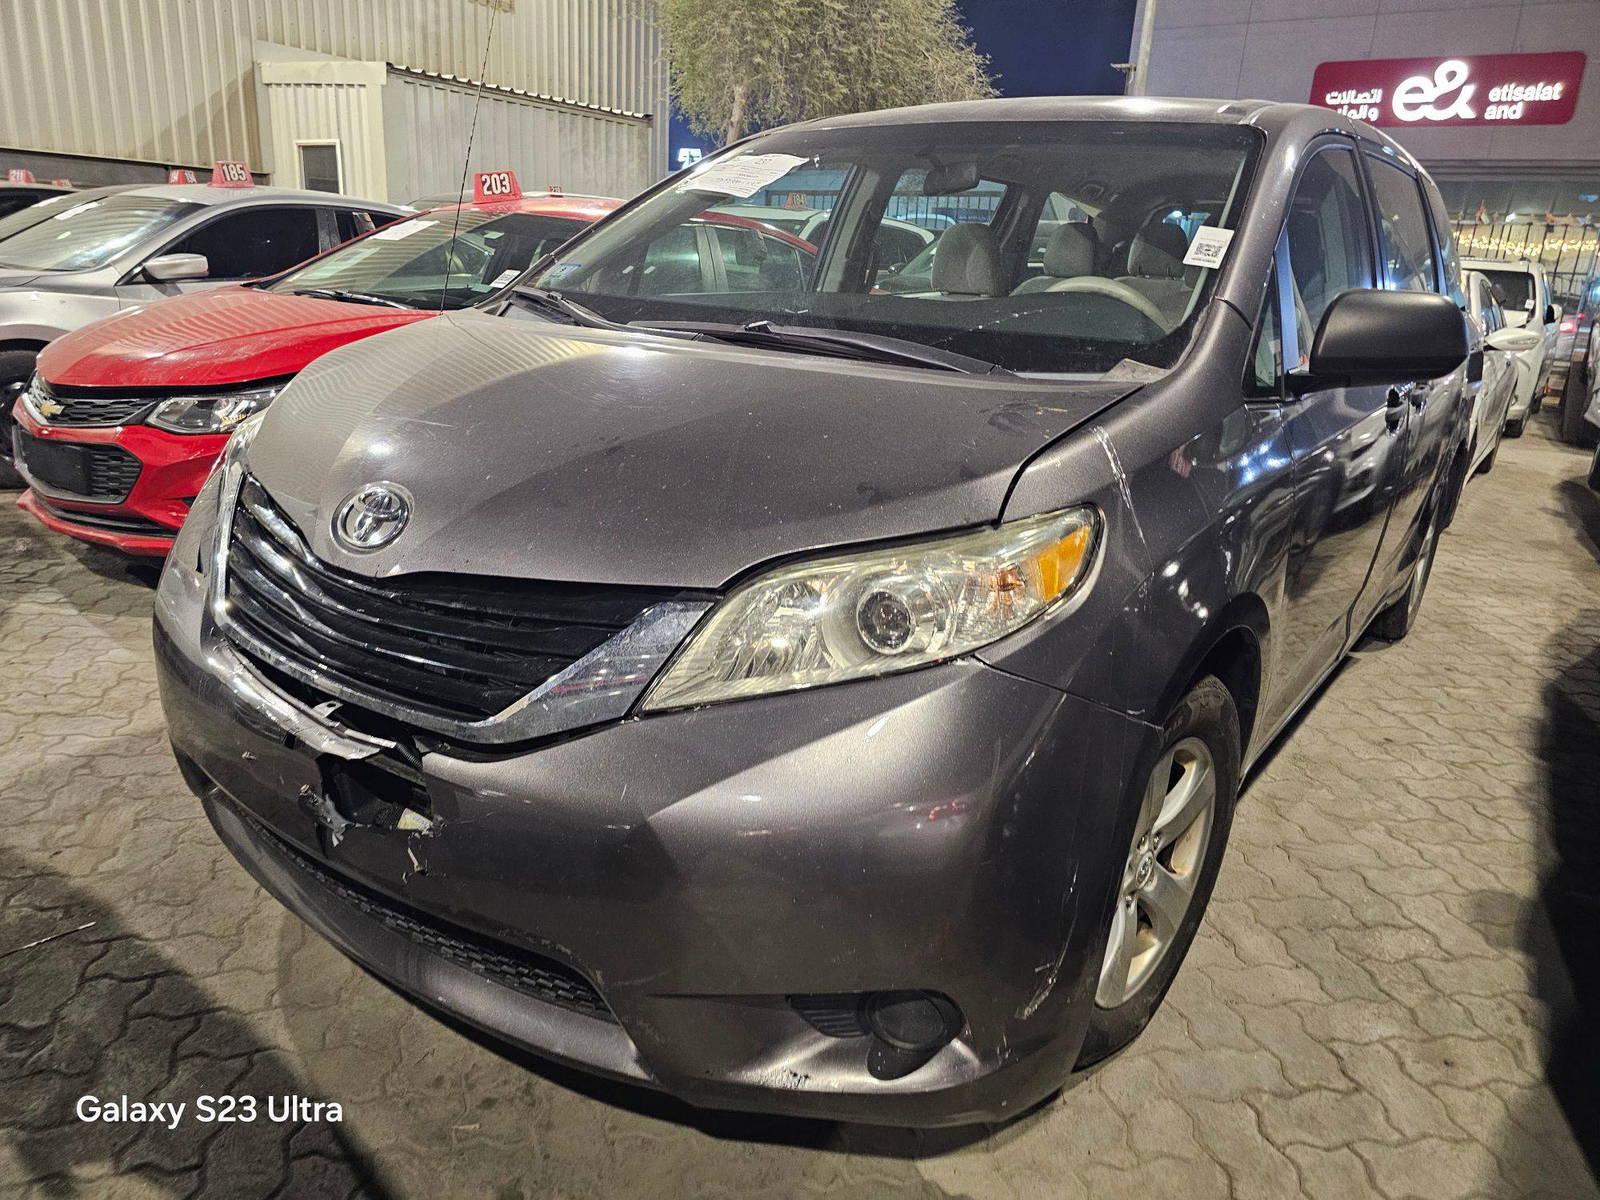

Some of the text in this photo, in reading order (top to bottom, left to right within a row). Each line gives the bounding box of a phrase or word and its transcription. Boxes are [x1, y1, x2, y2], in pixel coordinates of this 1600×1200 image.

[1325, 88, 1383, 105] اتصالات
[1488, 82, 1563, 102] etisalat
[1484, 101, 1523, 120] and
[222, 163, 247, 181] 185
[481, 173, 511, 197] 203
